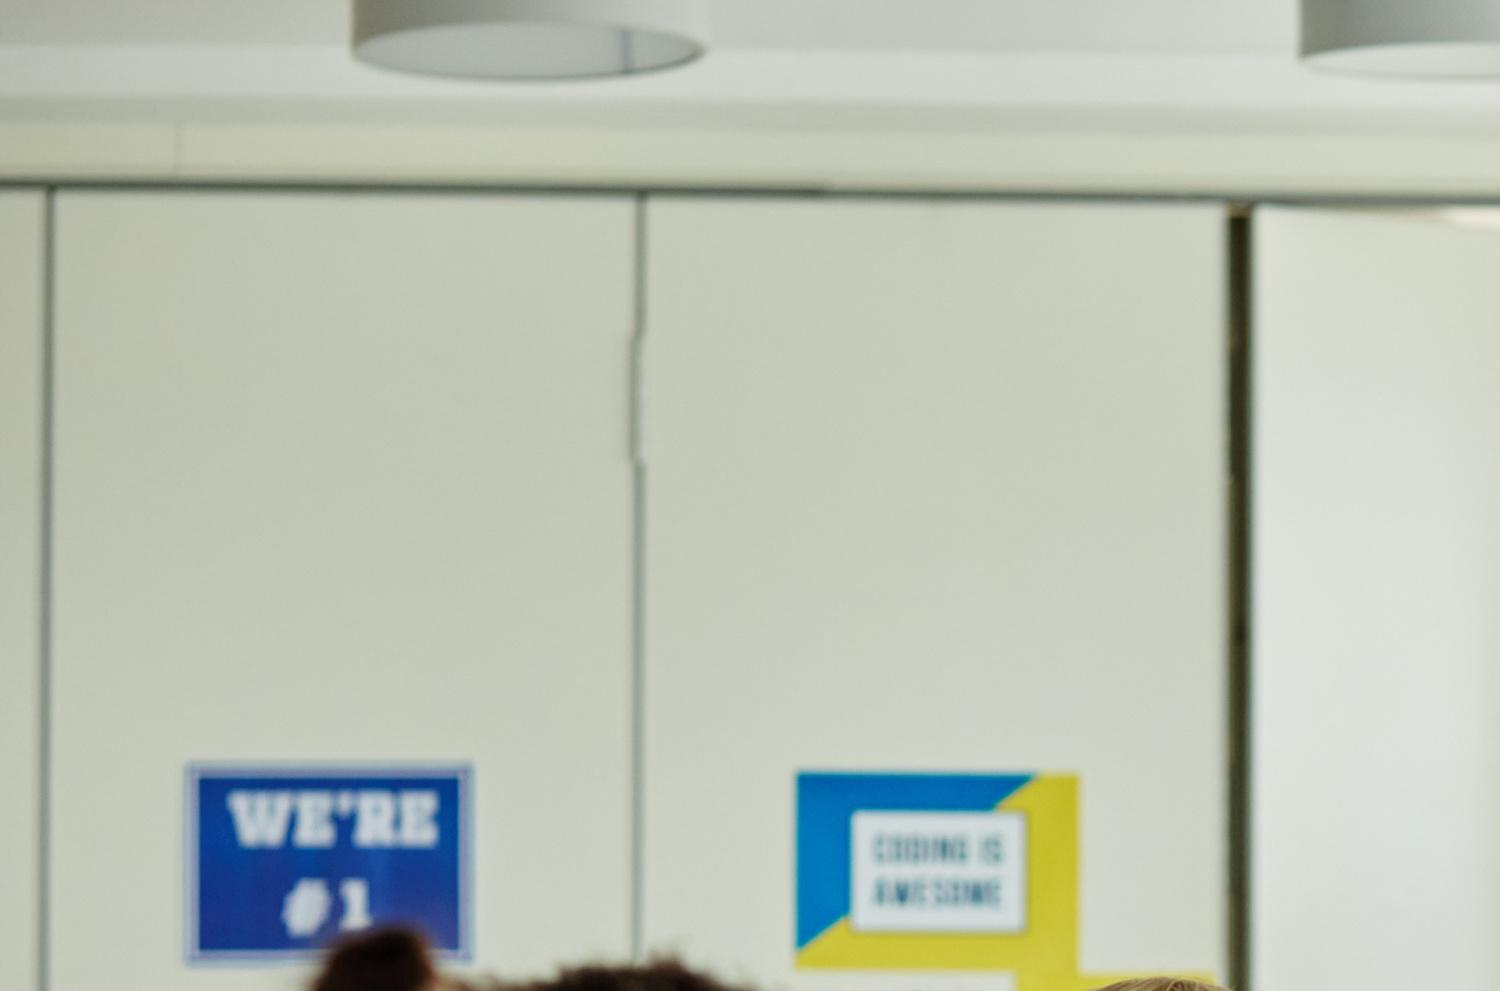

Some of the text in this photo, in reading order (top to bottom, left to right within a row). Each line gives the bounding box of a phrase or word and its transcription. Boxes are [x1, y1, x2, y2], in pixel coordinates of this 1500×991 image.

[227, 788, 440, 848] WE'RE
[874, 833, 1003, 865] CODING IS
[282, 877, 372, 937] #1
[874, 876, 1002, 907] AWESOME
